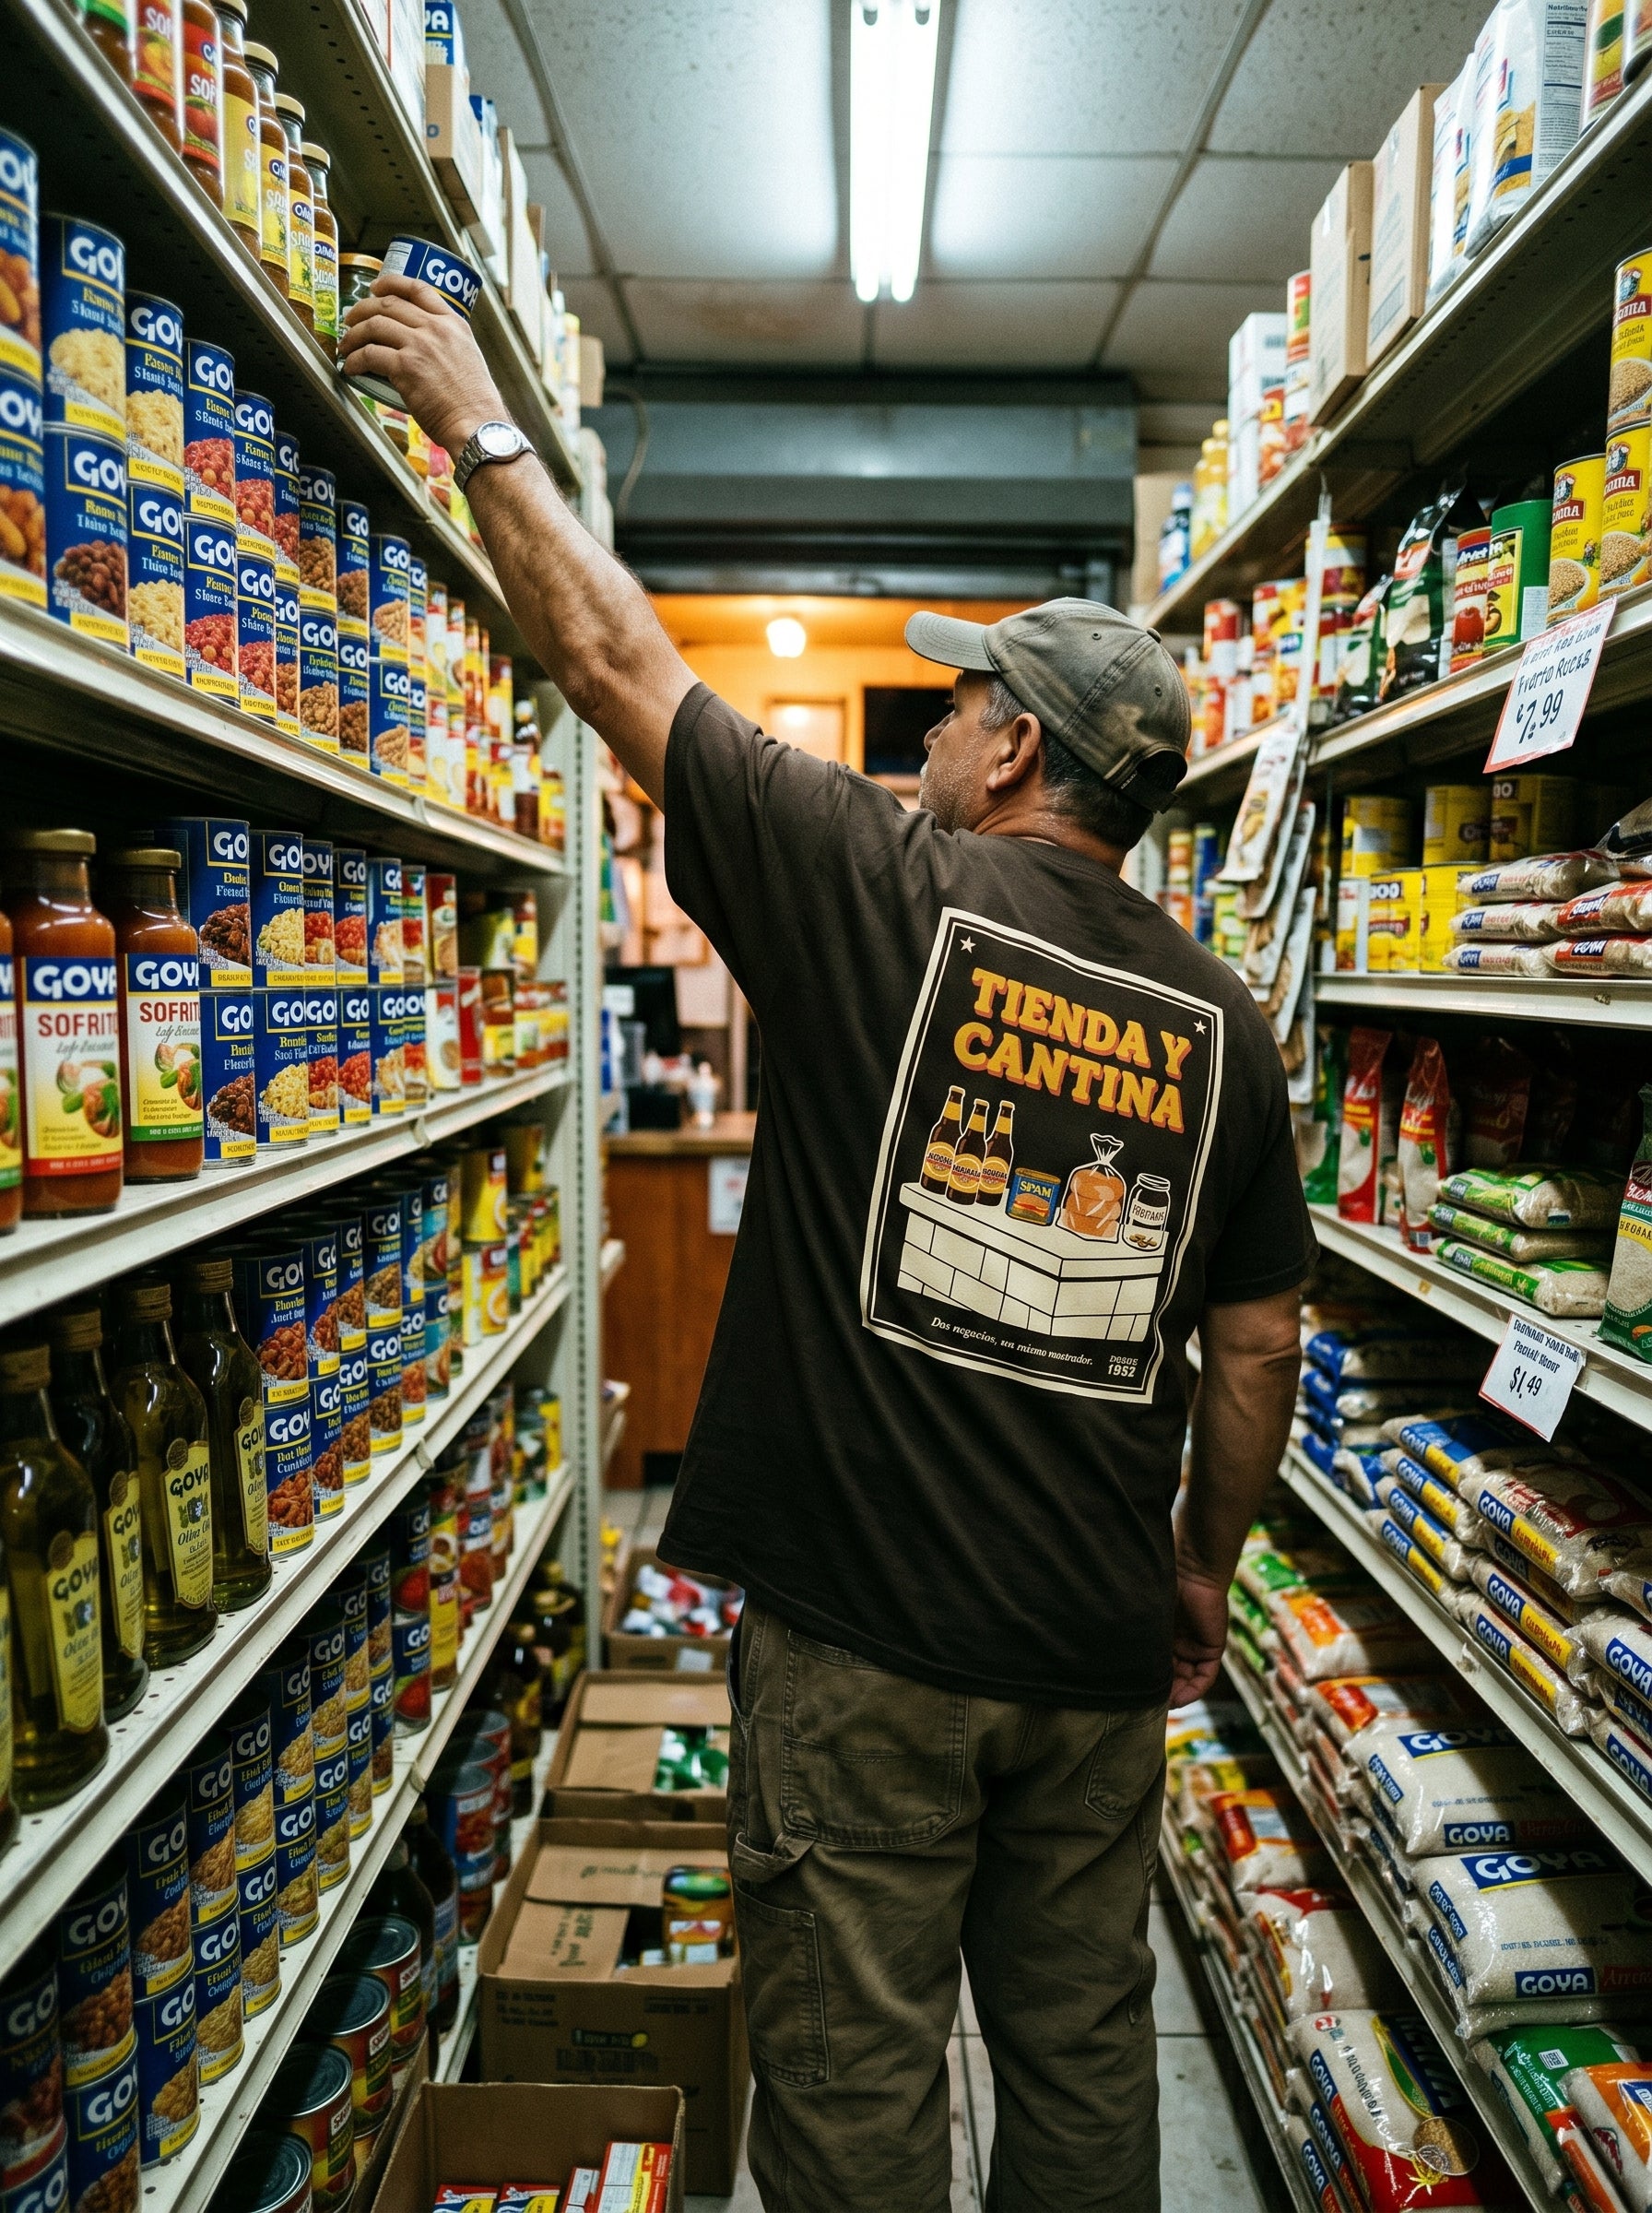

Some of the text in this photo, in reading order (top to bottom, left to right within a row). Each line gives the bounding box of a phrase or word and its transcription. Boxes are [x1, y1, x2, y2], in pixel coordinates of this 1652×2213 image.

[70, 236, 124, 282] GO
[426, 259, 479, 310] GOYA
[213, 832, 249, 859] GO
[269, 844, 303, 870] GO
[303, 854, 333, 874] OY
[972, 967, 1192, 1080] TIENDA Y
[953, 1022, 1185, 1133] CANTINA
[1020, 1180, 1052, 1198] SPAM
[372, 1211, 400, 1235] GO
[931, 1317, 950, 1330] Dos
[1107, 1365, 1137, 1378] 1952
[1510, 1366, 1542, 1399] $1.49
[315, 1631, 345, 1662] GO
[1609, 1645, 1652, 1696] GOYA
[1448, 1826, 1511, 1844] GOYA
[1475, 1852, 1607, 1881] GOYA
[1521, 1972, 1587, 1994] GOYA
[88, 2067, 137, 2124] GO
